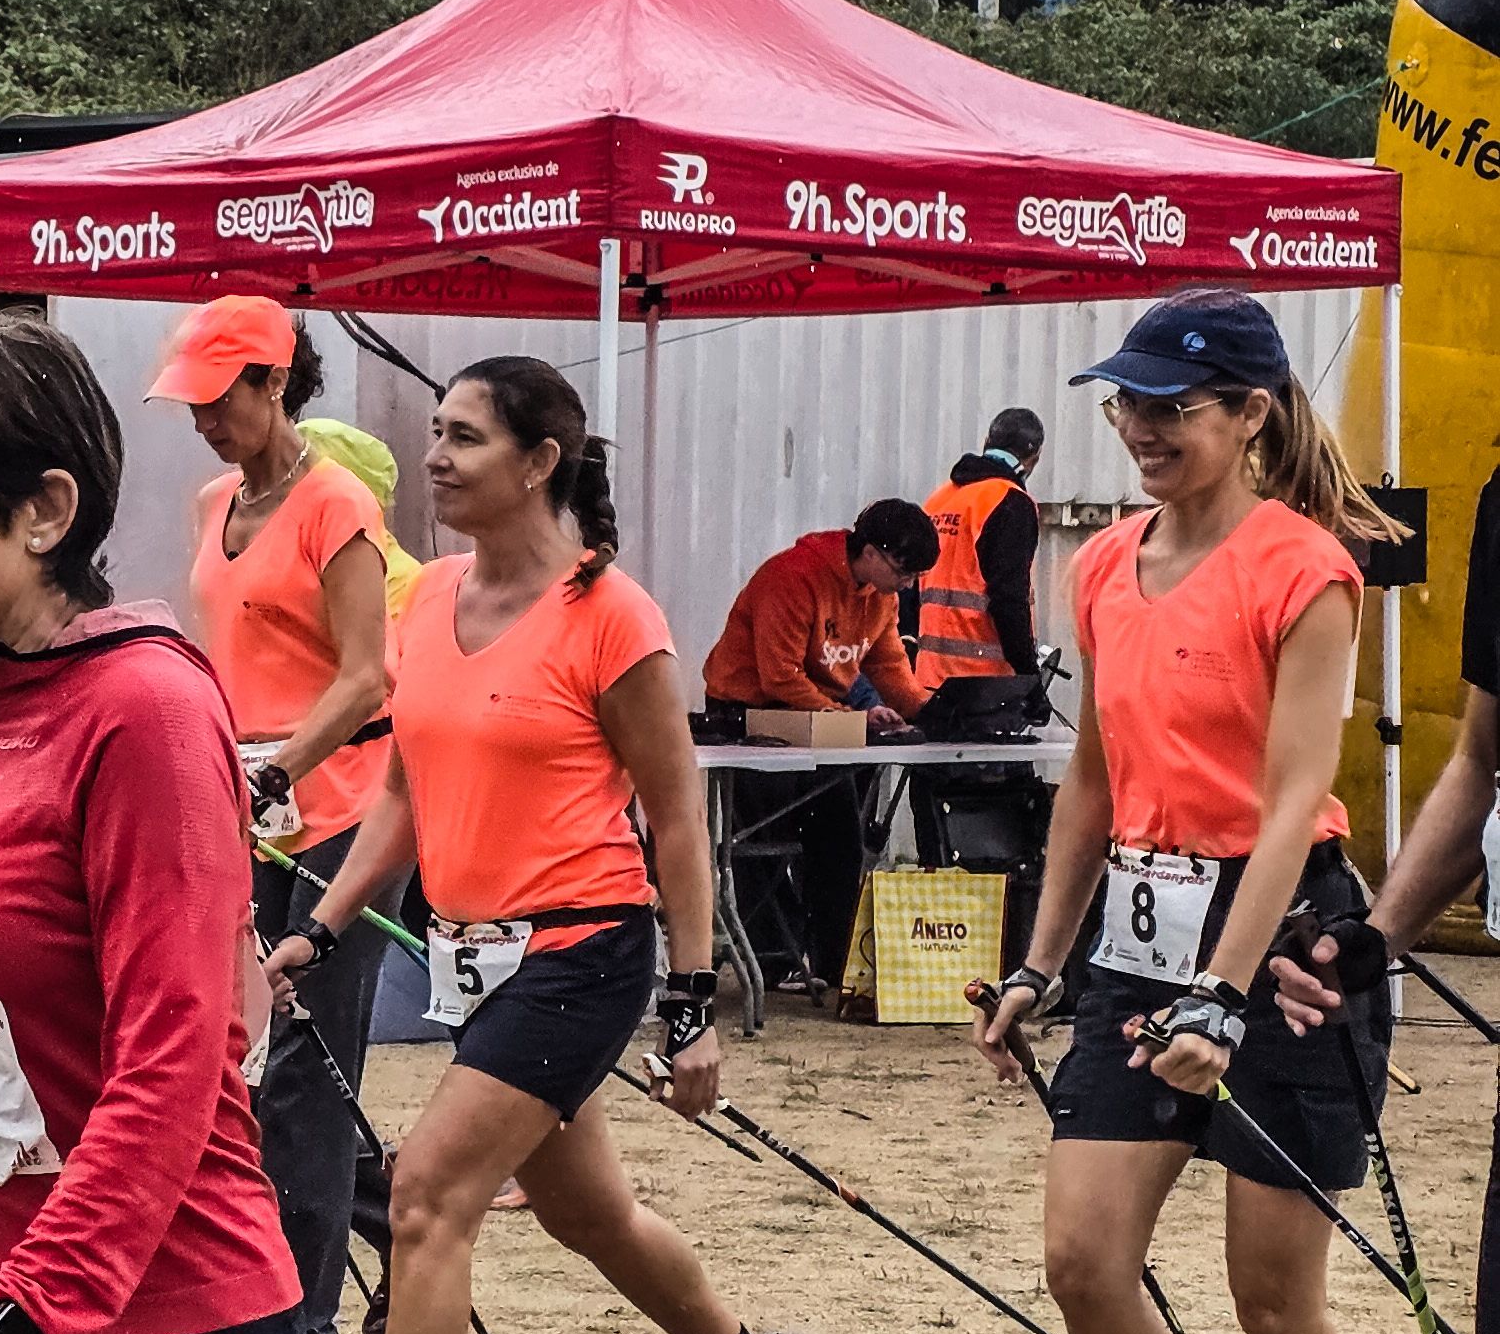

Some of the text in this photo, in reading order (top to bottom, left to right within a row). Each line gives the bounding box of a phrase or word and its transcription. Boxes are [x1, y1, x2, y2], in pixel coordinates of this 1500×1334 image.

[456, 160, 559, 188] Agencia exclusiva de
[451, 188, 581, 237] Occident
[640, 209, 736, 236] RUN&PRO
[786, 180, 967, 246] 9h.Sports
[1266, 205, 1360, 223] Agencia exclusiva de
[30, 211, 176, 272] 9h.Sports
[1261, 231, 1379, 268] Occident
[1131, 881, 1157, 944] 8
[454, 946, 485, 996] 5
